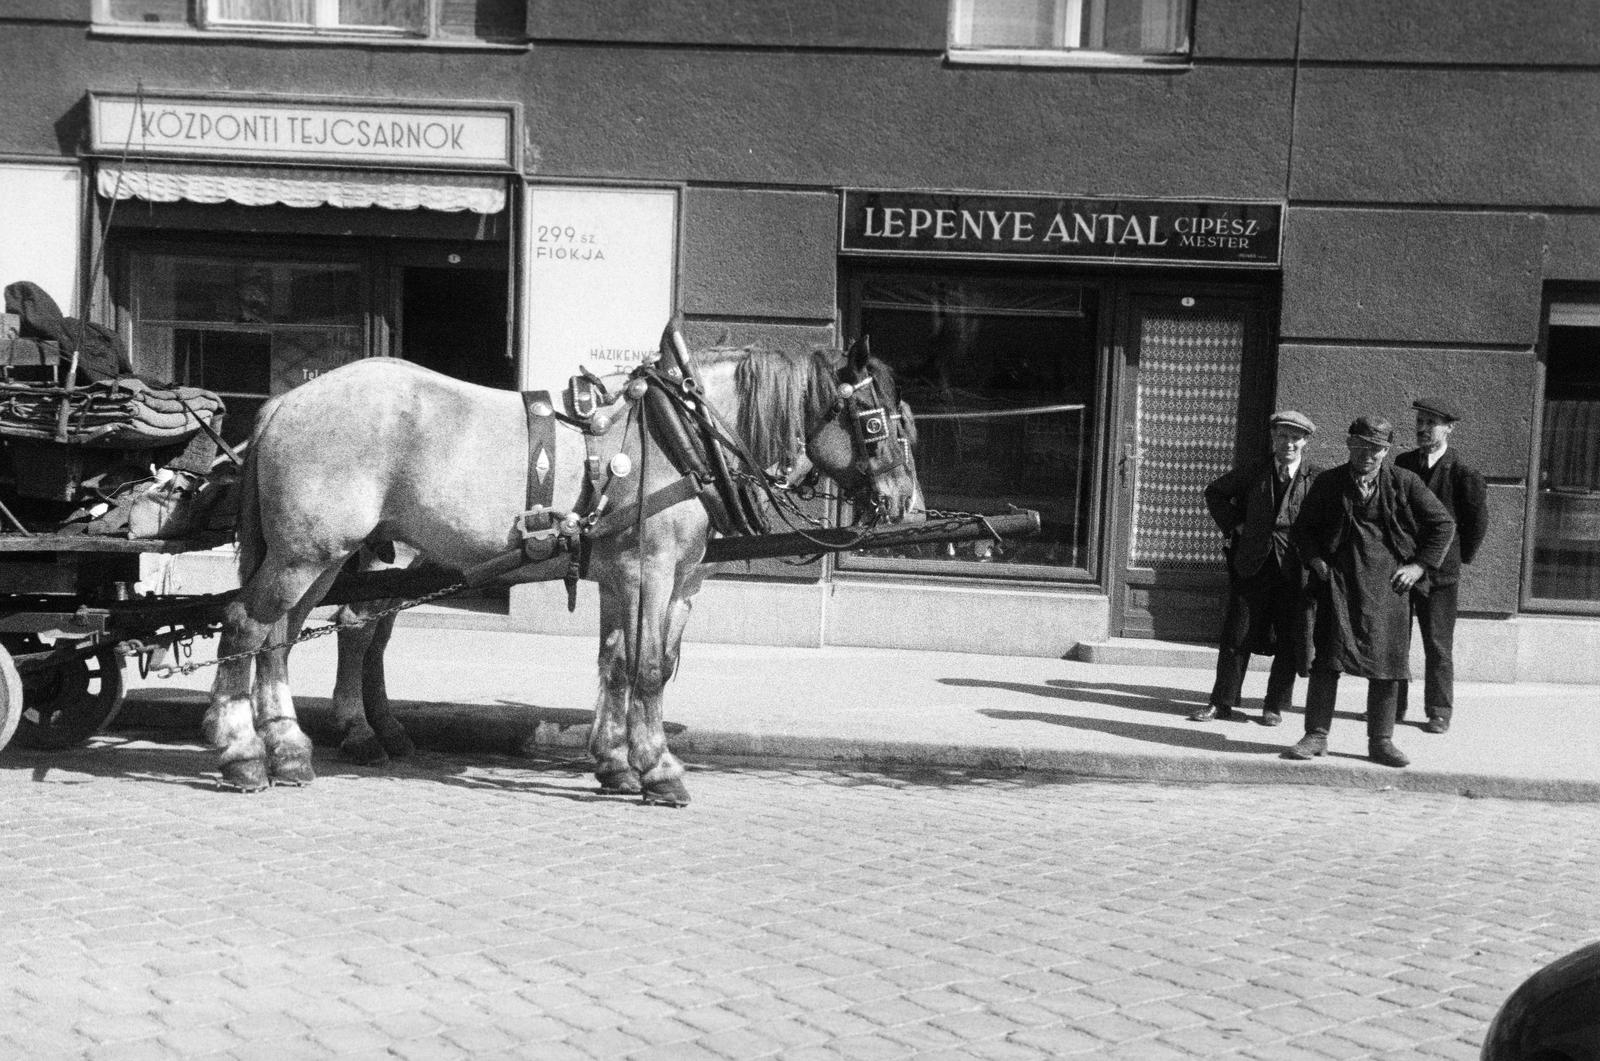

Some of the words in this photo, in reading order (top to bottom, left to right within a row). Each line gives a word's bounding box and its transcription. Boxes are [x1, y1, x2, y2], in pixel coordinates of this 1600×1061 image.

[142, 110, 277, 144] KÖZPONTI
[288, 117, 465, 150] TEJCSARNOK
[864, 207, 1036, 241] LEPENYE
[1043, 213, 1168, 246] ANTAL
[1179, 235, 1249, 249] MESTER
